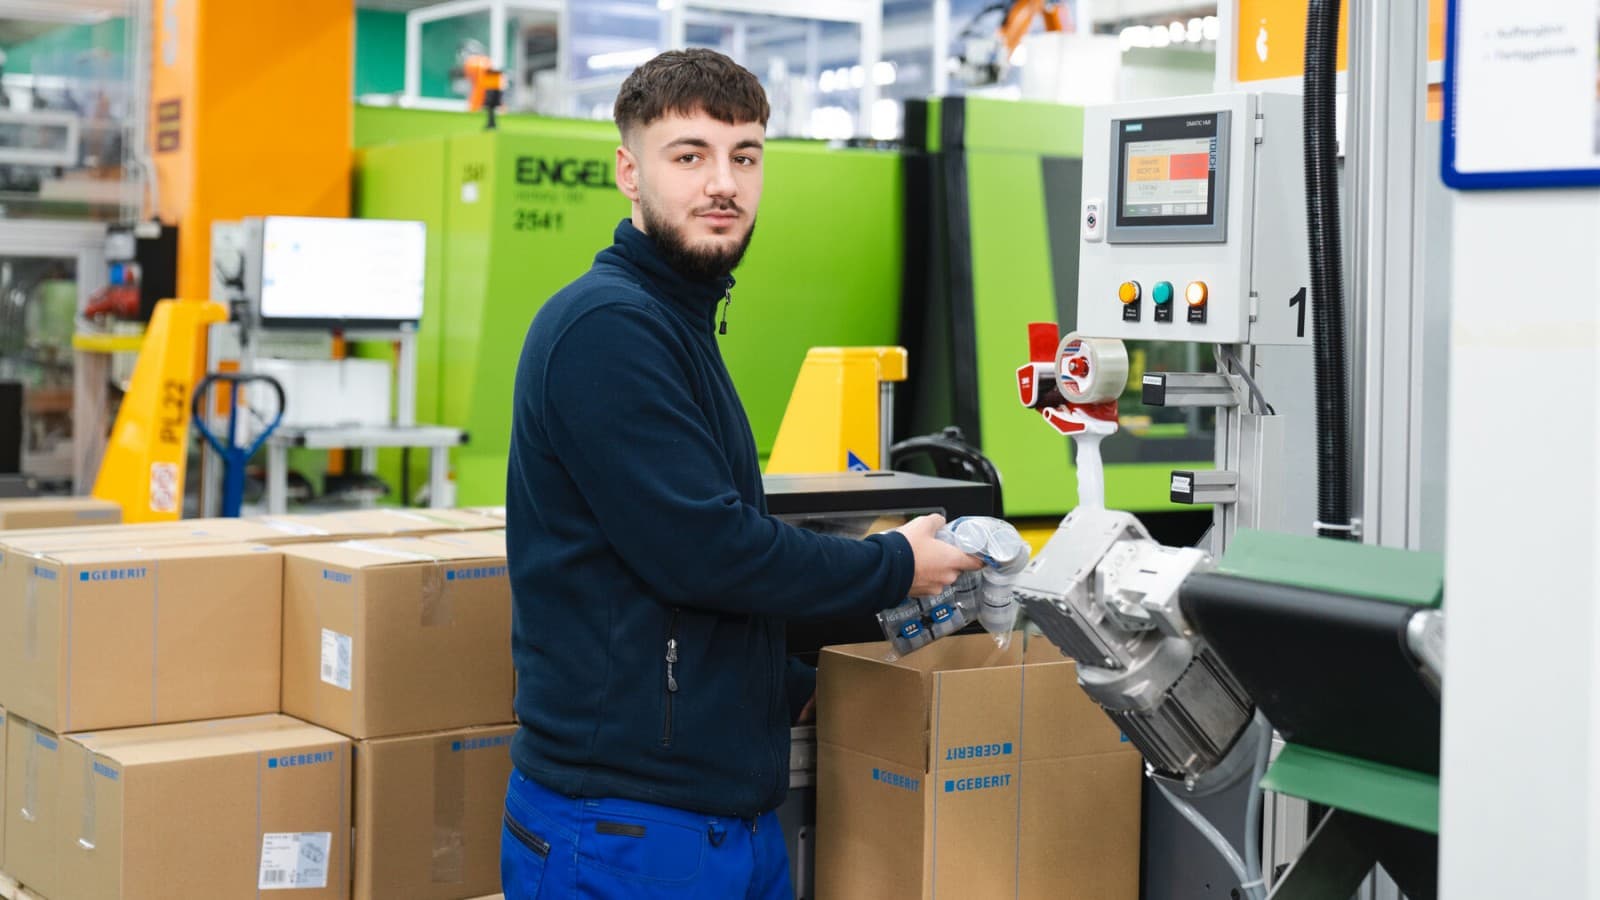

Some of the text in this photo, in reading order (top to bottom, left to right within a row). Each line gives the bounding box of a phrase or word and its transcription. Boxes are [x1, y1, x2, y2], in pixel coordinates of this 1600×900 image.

[1208, 137, 1217, 171] TOUCH
[515, 156, 617, 189] ENGEL
[513, 209, 564, 231] 2541
[1289, 287, 1307, 337] 1
[160, 378, 186, 445] PL22
[92, 567, 147, 581] GEBERIT
[280, 751, 335, 769] GEBERIT
[945, 743, 1001, 761] GEBERIT
[880, 769, 920, 792] GEBERIT
[956, 774, 1012, 792] GEBERIT
